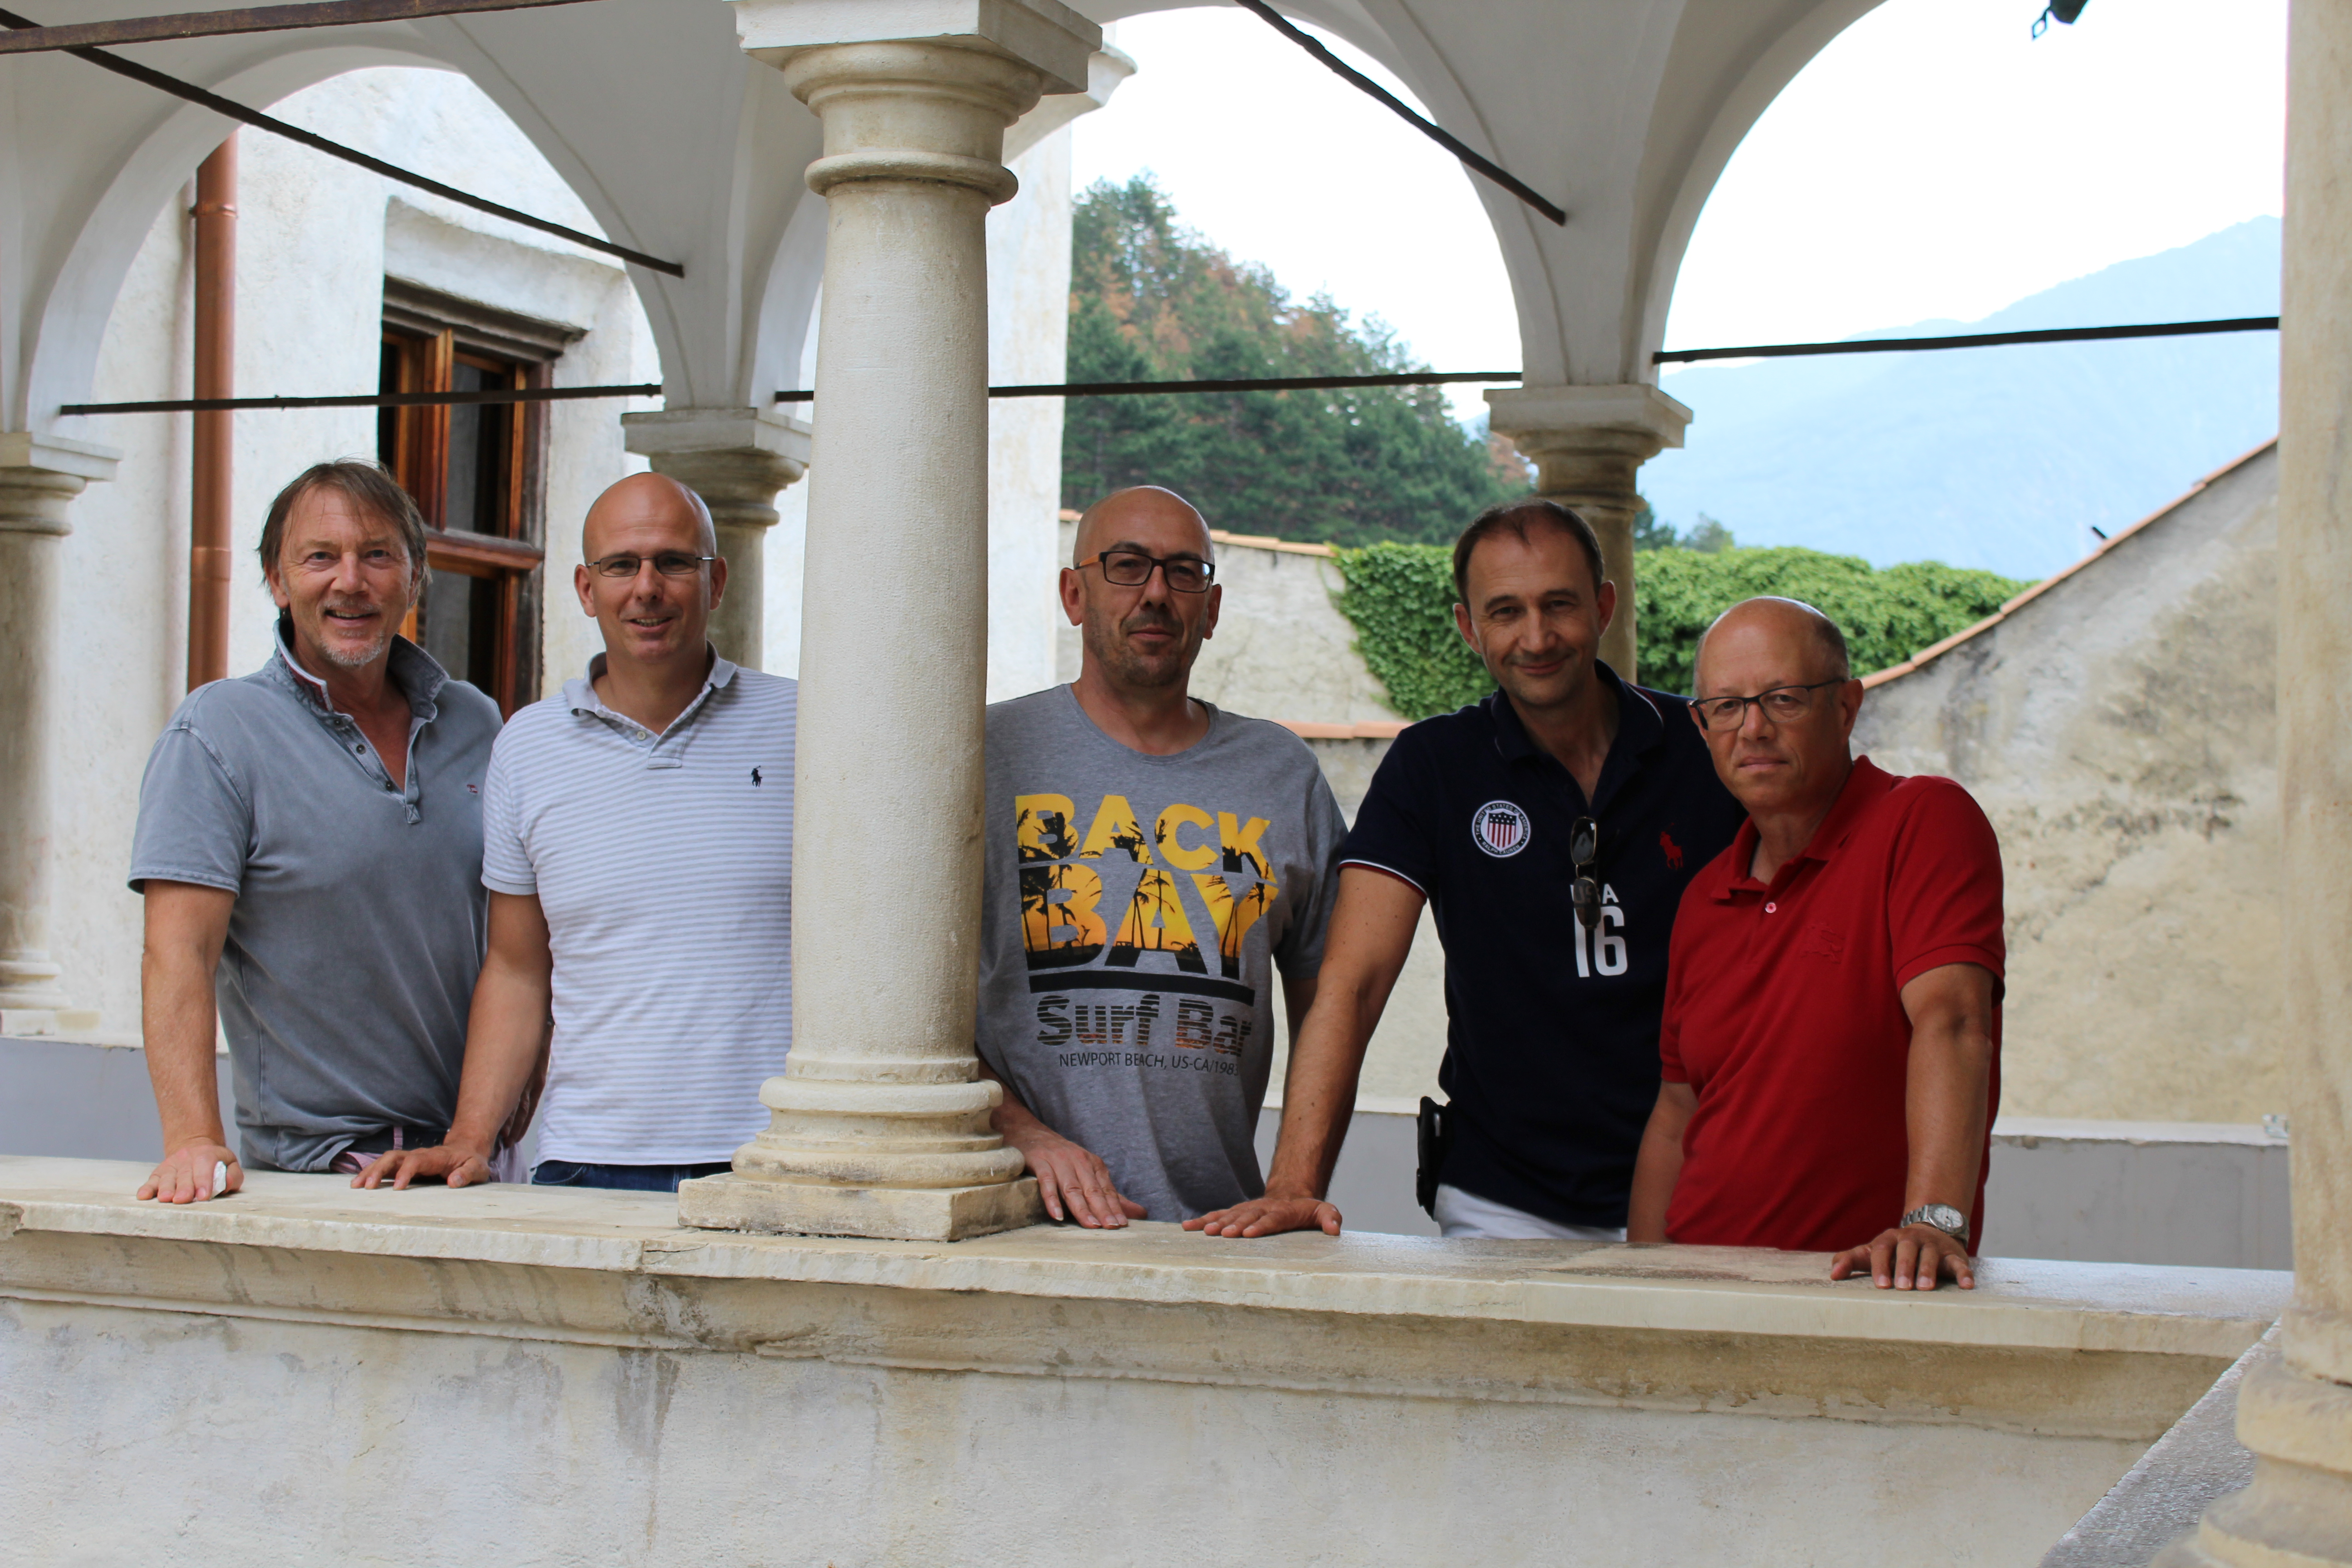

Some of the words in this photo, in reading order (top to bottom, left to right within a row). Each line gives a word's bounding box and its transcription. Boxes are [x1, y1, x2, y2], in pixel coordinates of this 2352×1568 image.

[1015, 793, 1277, 884] BACK
[1482, 841, 1498, 853] RALPH
[1499, 844, 1520, 854] LAUREN
[1520, 816, 1528, 839] AMERICA
[1019, 864, 1279, 981] BAY
[1574, 906, 1628, 977] 16
[1037, 994, 1160, 1046] Surf
[1175, 999, 1252, 1057] Bar
[1059, 1052, 1121, 1067] NEWPORT
[1125, 1053, 1166, 1069] BEACH,
